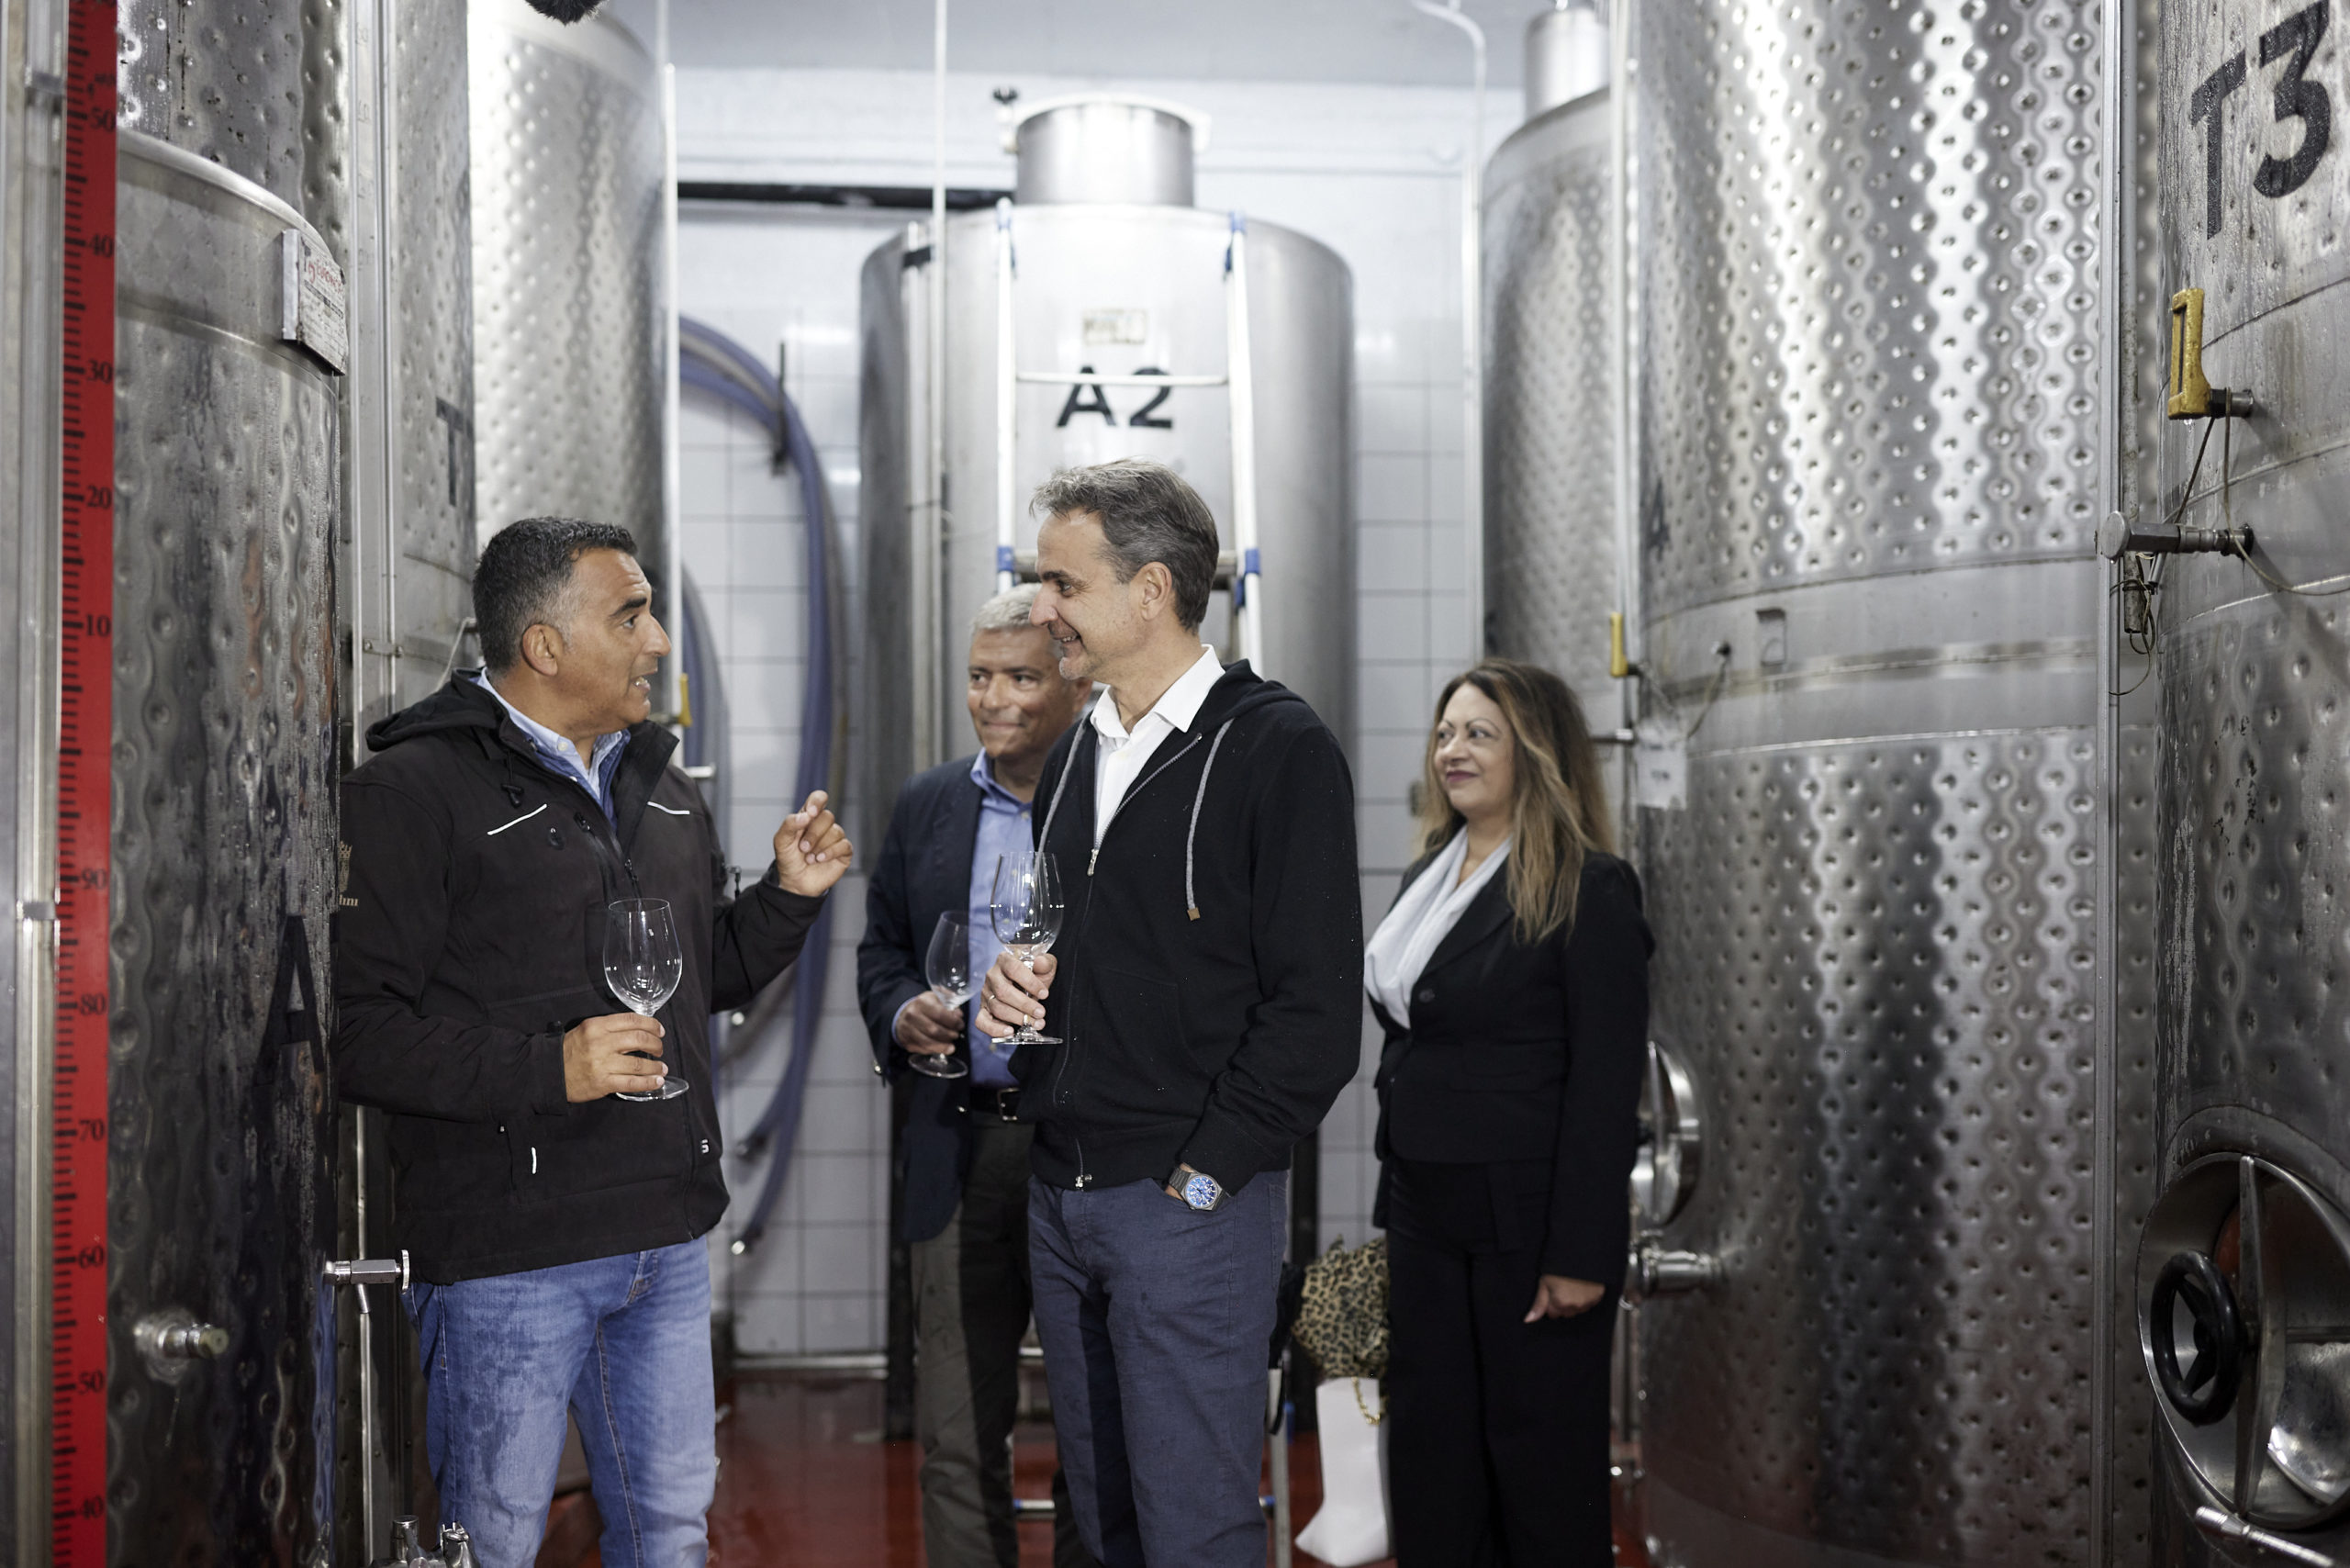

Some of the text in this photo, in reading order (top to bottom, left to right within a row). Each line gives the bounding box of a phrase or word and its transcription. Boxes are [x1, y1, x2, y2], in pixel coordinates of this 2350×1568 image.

[90, 107, 117, 132] 50
[2191, 0, 2332, 241] T3
[89, 234, 115, 259] 40
[87, 359, 113, 385] 30
[1057, 364, 1172, 429] A2
[86, 484, 112, 510] 20
[85, 614, 111, 638] 10
[81, 868, 107, 890] 90
[80, 993, 106, 1016] 80
[77, 1117, 104, 1142] 70
[78, 1245, 104, 1270] 60
[77, 1369, 104, 1395] 50
[79, 1495, 104, 1521] 40
